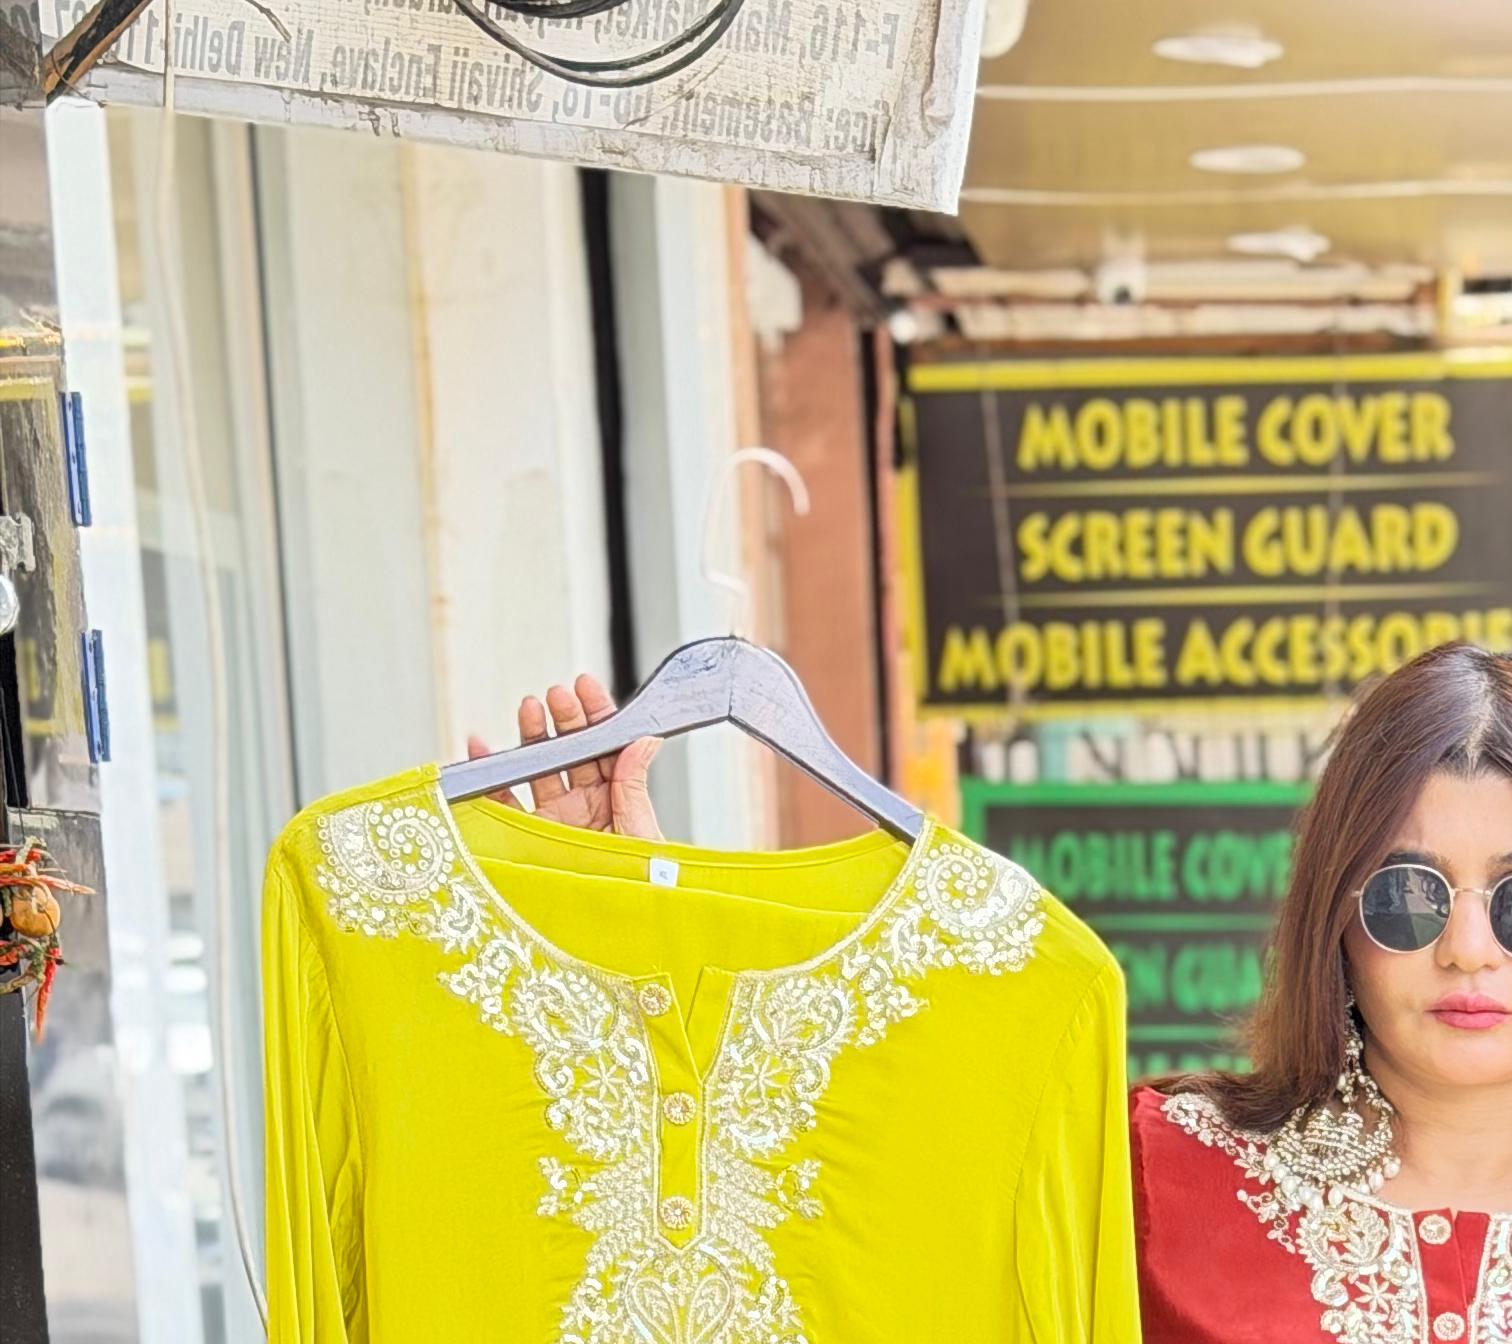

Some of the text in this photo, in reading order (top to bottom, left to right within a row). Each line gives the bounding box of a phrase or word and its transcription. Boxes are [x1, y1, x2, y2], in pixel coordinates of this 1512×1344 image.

[1016, 393, 1455, 471] MOBILE COVER
[1017, 503, 1458, 582] SCREEN GUARD
[940, 620, 1166, 692] MOBILE
[1183, 830, 1293, 901] COVE
